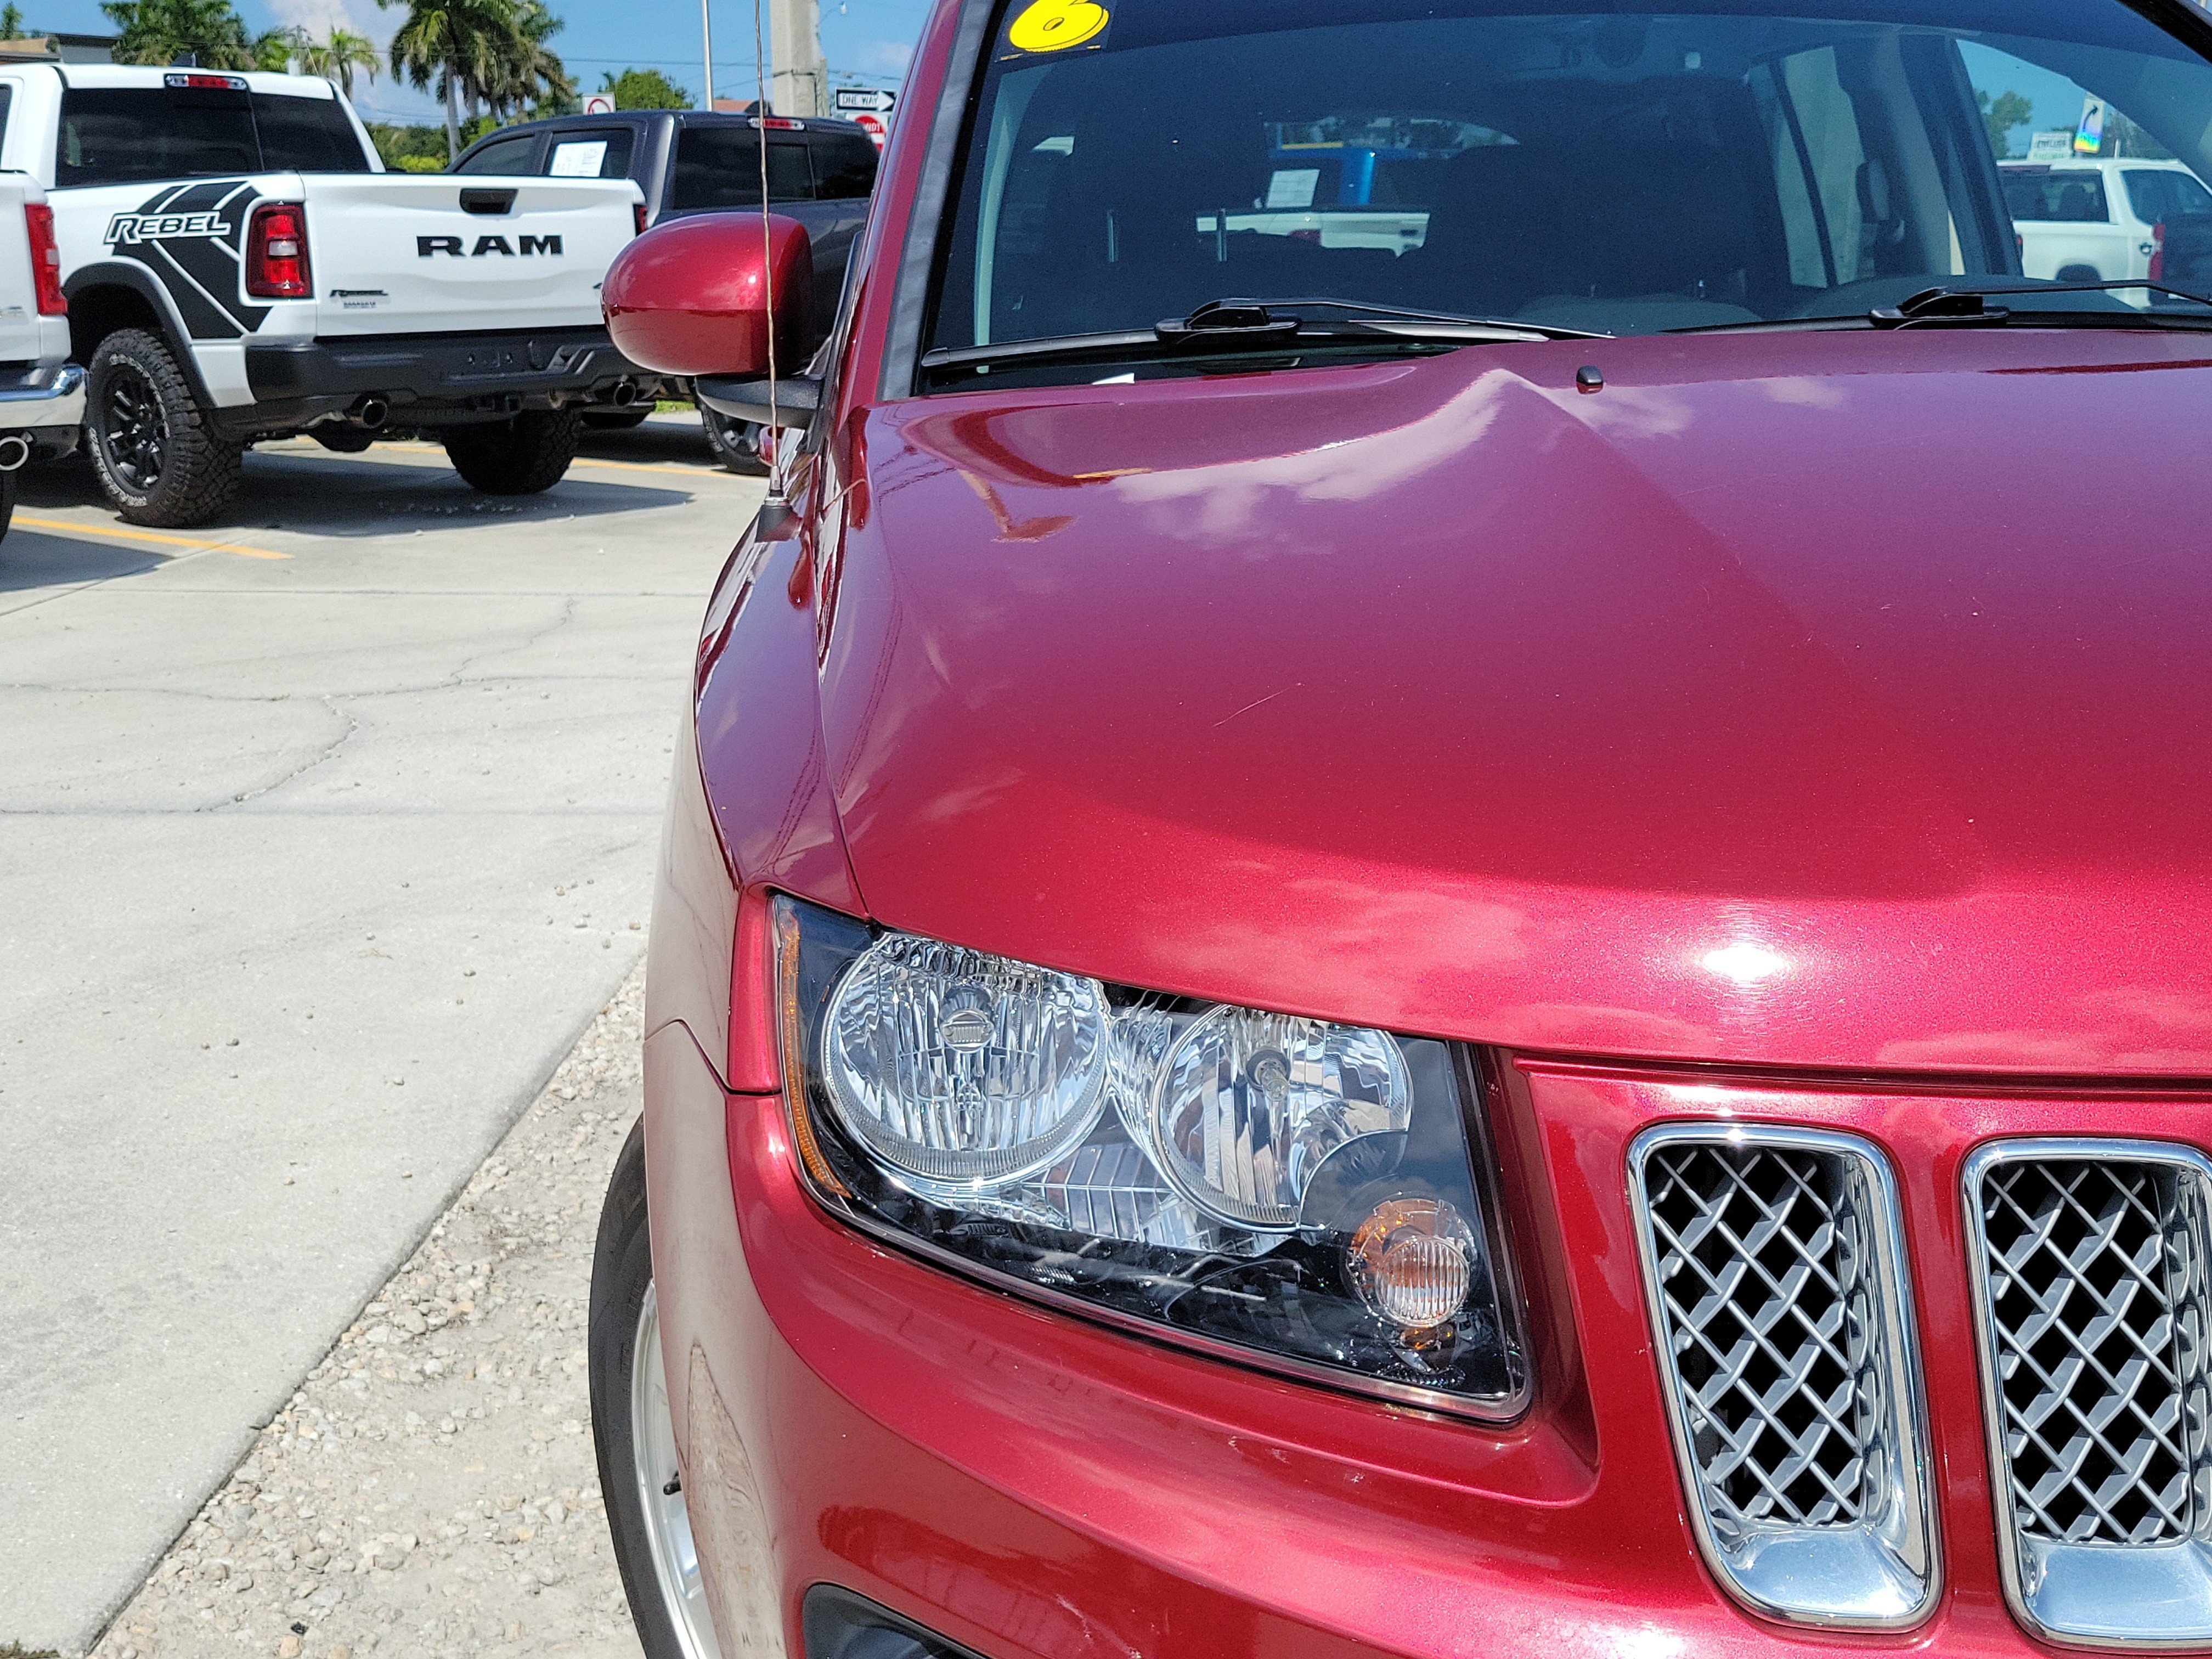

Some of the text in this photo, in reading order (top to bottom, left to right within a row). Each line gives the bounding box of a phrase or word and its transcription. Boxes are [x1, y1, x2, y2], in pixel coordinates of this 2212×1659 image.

[842, 95, 878, 105] ONE WAY
[105, 213, 230, 243] REBEL
[416, 235, 562, 257] RAM
